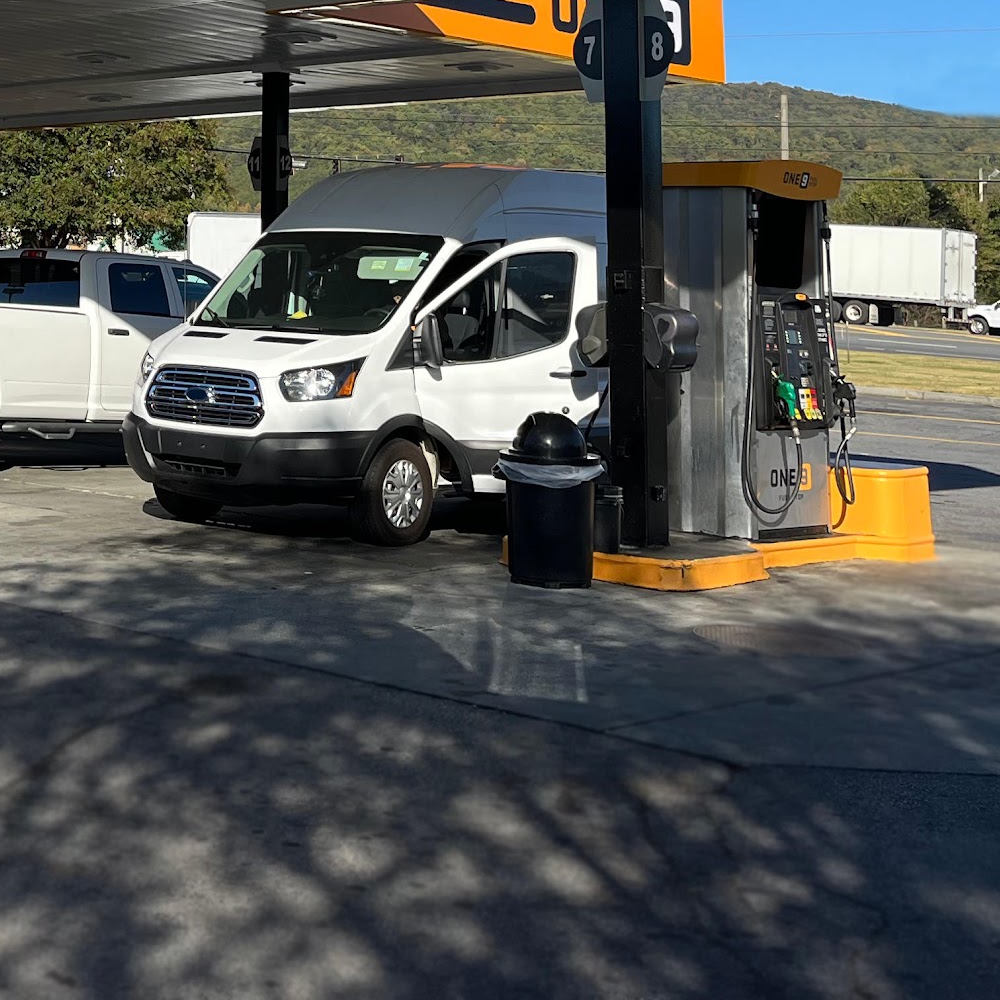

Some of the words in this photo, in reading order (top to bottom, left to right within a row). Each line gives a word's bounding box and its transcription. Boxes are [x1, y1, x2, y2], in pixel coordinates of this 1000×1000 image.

[584, 36, 596, 65] 7
[651, 32, 664, 61] 8
[249, 156, 260, 172] 11
[280, 155, 291, 171] 12
